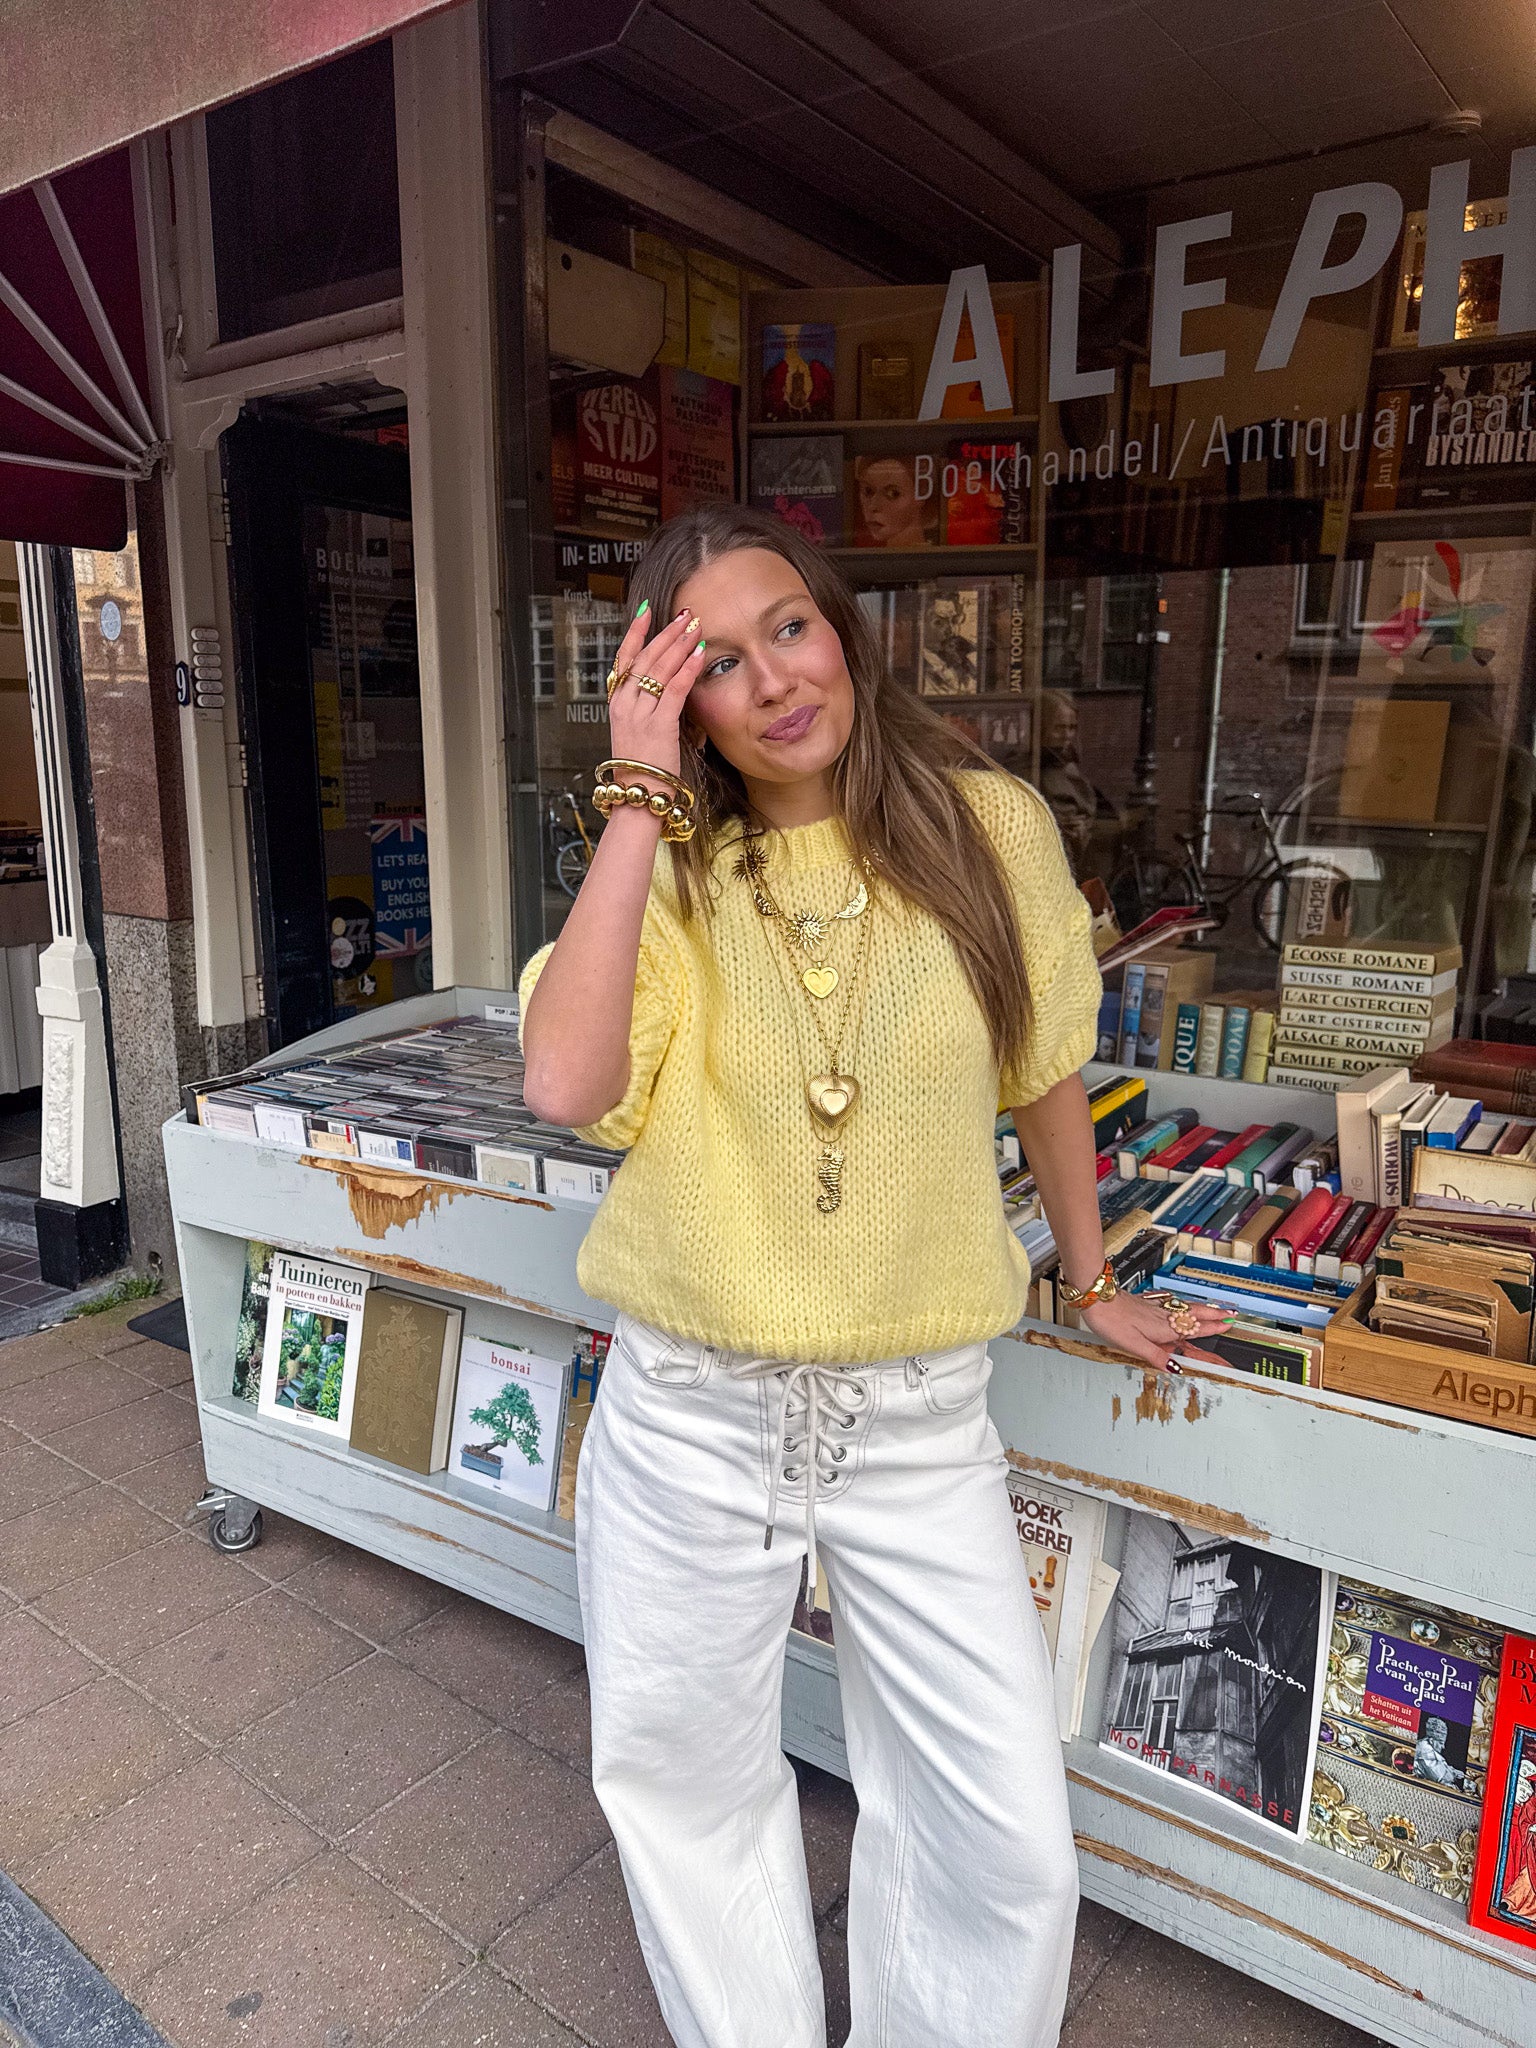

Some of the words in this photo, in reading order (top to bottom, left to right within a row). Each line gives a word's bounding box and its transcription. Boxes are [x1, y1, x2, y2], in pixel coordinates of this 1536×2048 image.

[917, 145, 1536, 421] ALEPH
[583, 384, 657, 424] WERELD
[582, 408, 657, 463] STAD
[914, 385, 1535, 501] Boekhandel/Antiquariaat
[583, 461, 613, 481] MEER
[758, 484, 836, 497] Utrechtenaren
[562, 545, 584, 567] IN-
[588, 544, 609, 565] EN
[613, 541, 647, 564] VER
[563, 588, 592, 603] Kunst
[565, 611, 620, 625] Architectu
[1010, 608, 1024, 665] TOOROP
[176, 667, 187, 703] 9
[1010, 669, 1023, 694] JAN
[377, 854, 405, 868] LET'S
[407, 854, 427, 867] REA
[381, 878, 405, 892] BUY
[407, 876, 430, 889] YOU
[377, 909, 414, 923] BOOKS
[416, 906, 430, 919] HE
[1290, 946, 1346, 964] ÉCOSSE
[1353, 954, 1428, 971] ROMANE
[1290, 971, 1342, 986] SUISSE
[1352, 976, 1425, 993] ROMANE
[1285, 990, 1331, 1006] L'ART
[1333, 996, 1429, 1015] CISTERCIEN
[1286, 1012, 1326, 1025] L'ART
[1332, 1017, 1422, 1034] CISTERCIEN
[1280, 1030, 1339, 1046] ALSACE
[1346, 1036, 1422, 1055] ROMANE
[1281, 1051, 1335, 1069] ÉMILIE
[1276, 1074, 1340, 1092] BELGIQUE
[258, 1272, 269, 1283] en
[279, 1259, 362, 1296] Tuinieren
[276, 1282, 284, 1293] in
[286, 1287, 315, 1301] potten
[317, 1294, 328, 1303] en
[329, 1294, 362, 1311] bakken
[490, 1352, 531, 1375] bonsai
[1432, 1370, 1536, 1418] Aleph
[1183, 1631, 1213, 1650] Piet
[1375, 1637, 1419, 1674] Pracht
[1424, 1670, 1440, 1682] en
[1437, 1658, 1472, 1694] Praal
[1384, 1667, 1407, 1682] van
[1403, 1680, 1419, 1694] de
[1414, 1672, 1446, 1707] Paus
[1369, 1705, 1381, 1716] het
[1381, 1708, 1412, 1727] Vaticaan
[1370, 1695, 1400, 1713] Schatten
[1402, 1706, 1412, 1716] uit
[1110, 1728, 1294, 1825] MONTPARNASSE
